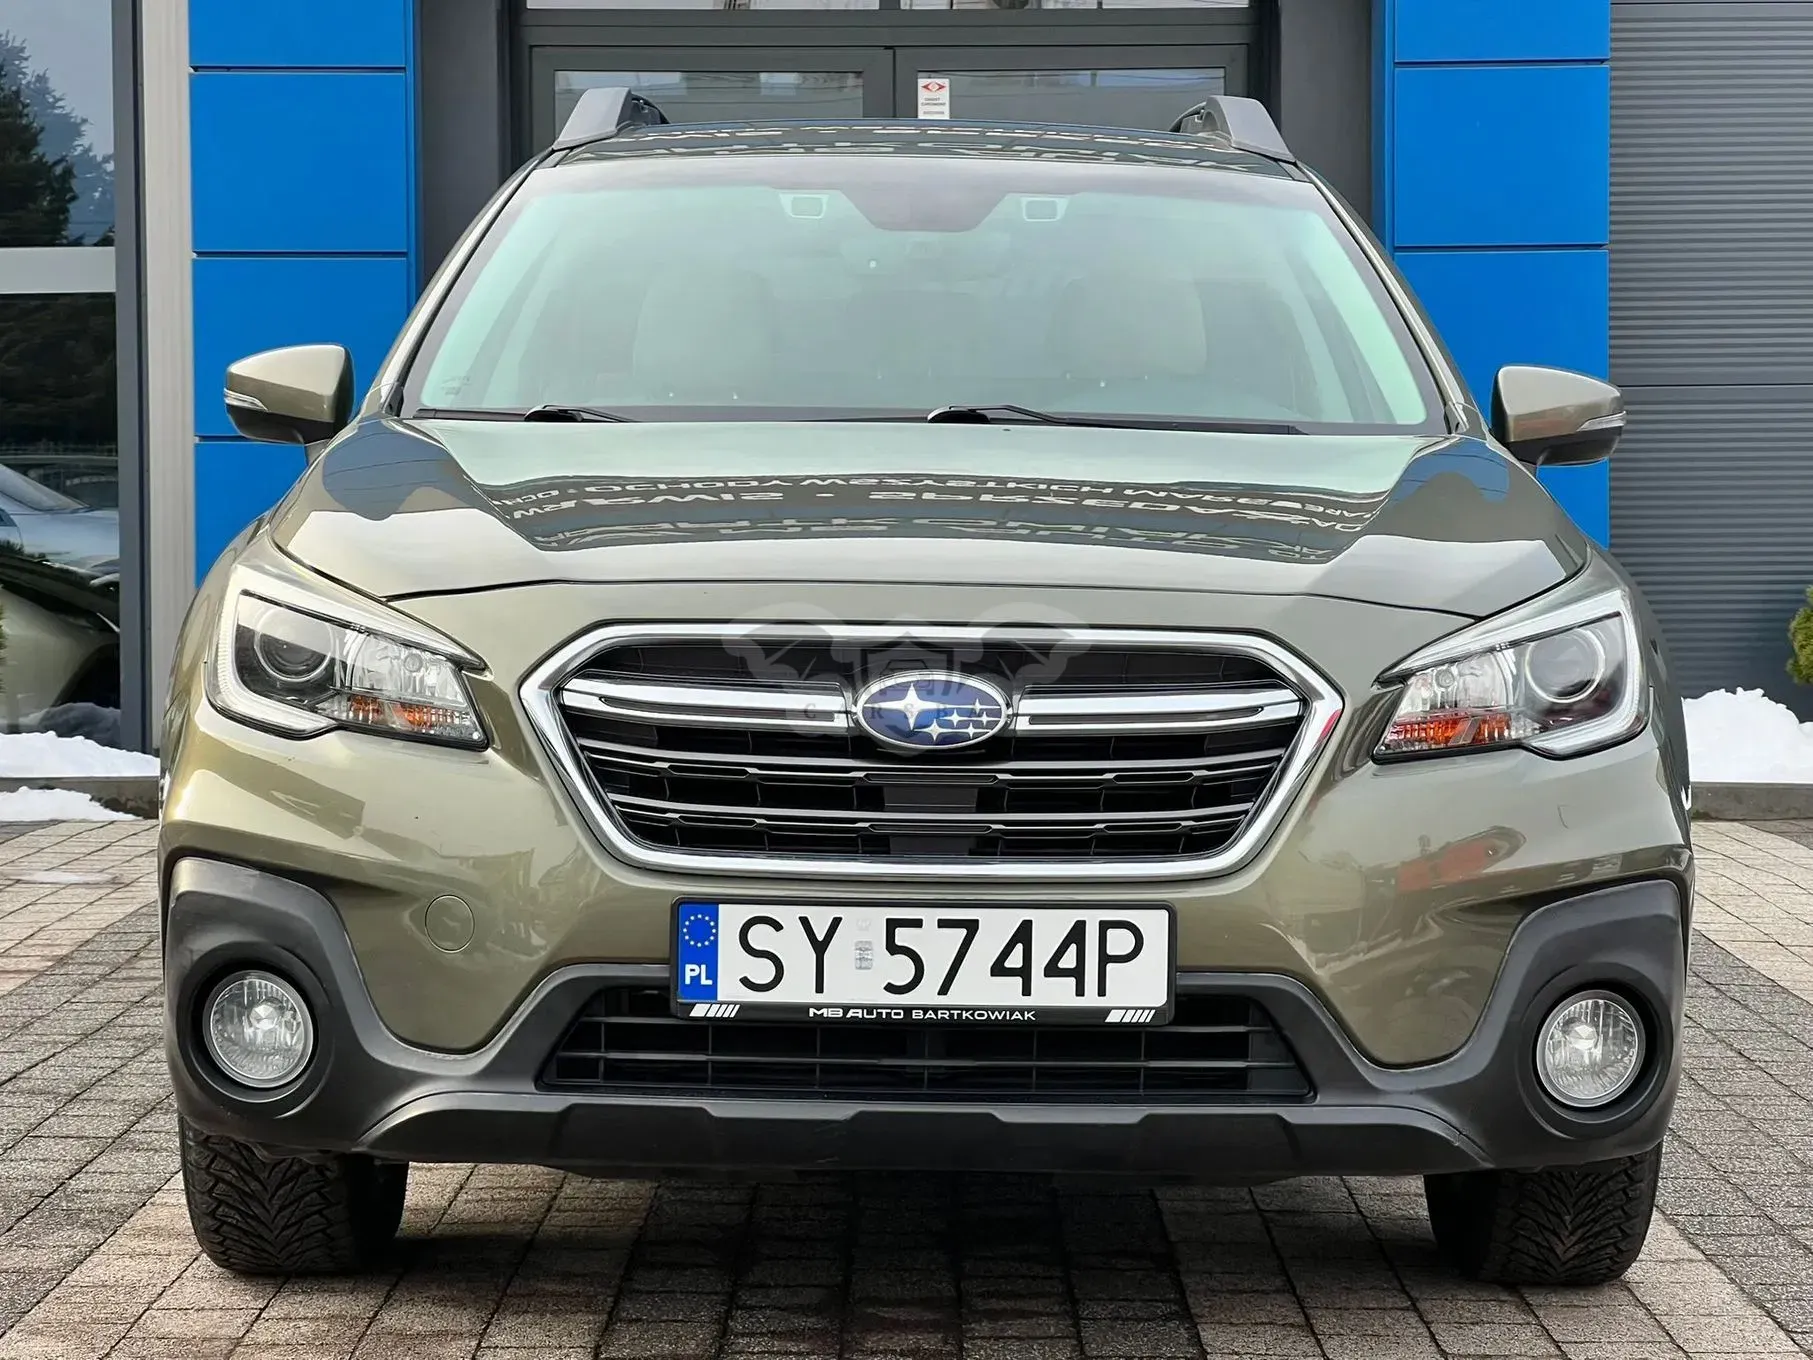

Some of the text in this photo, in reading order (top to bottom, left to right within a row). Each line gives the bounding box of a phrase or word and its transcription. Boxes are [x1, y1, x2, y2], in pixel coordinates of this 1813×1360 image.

[738, 914, 1145, 998] SY 5744P
[684, 964, 713, 986] PL
[808, 1007, 1037, 1021] MB AUTO BARTKOWIAK
